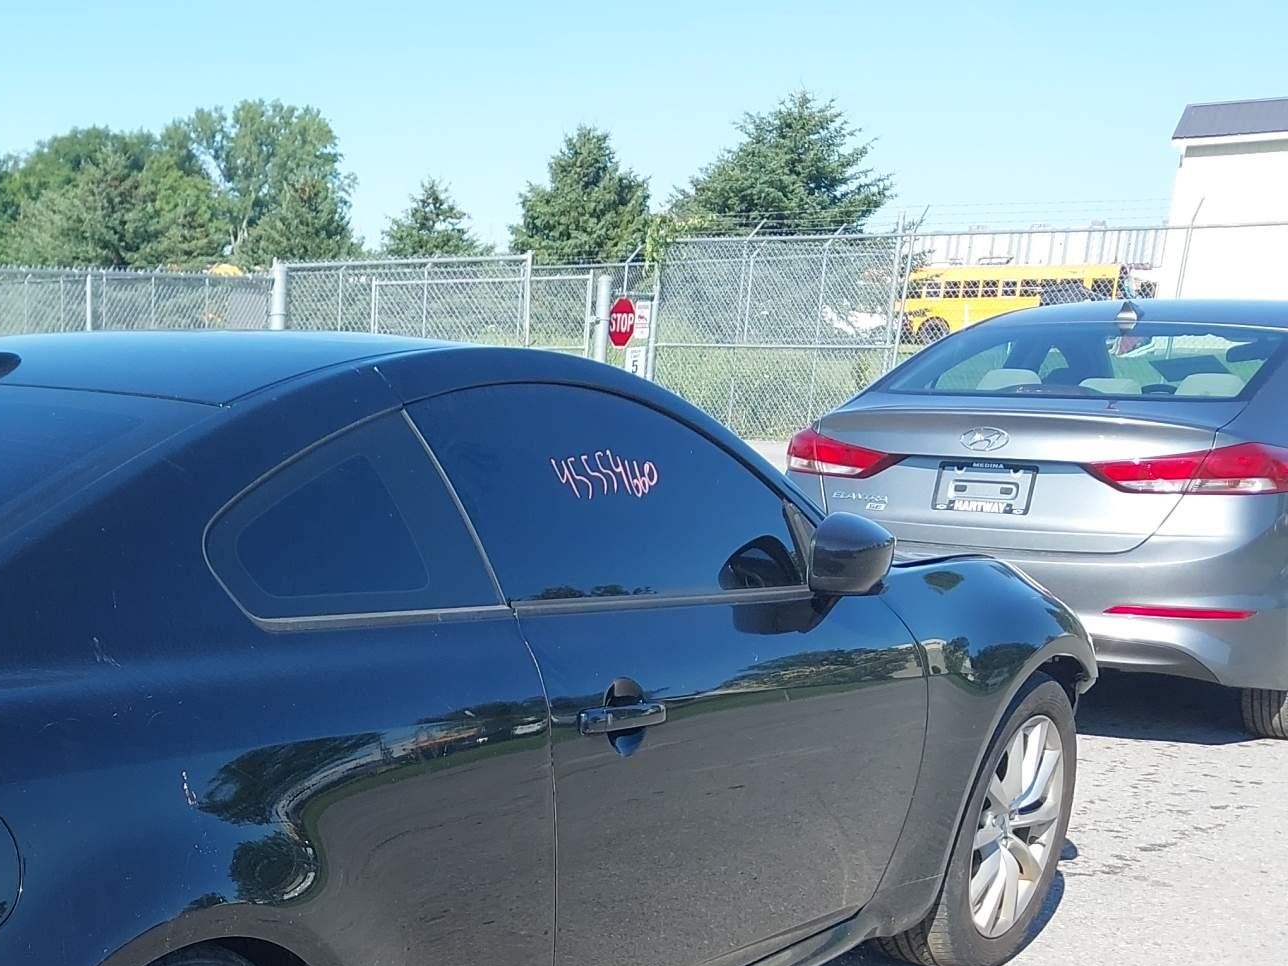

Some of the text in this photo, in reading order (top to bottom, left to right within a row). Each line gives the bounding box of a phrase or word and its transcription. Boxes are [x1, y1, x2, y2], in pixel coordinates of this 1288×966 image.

[610, 312, 634, 333] STOP
[631, 360, 638, 374] 5
[550, 449, 658, 500] 45554660
[953, 499, 1008, 514] HARTWAY
